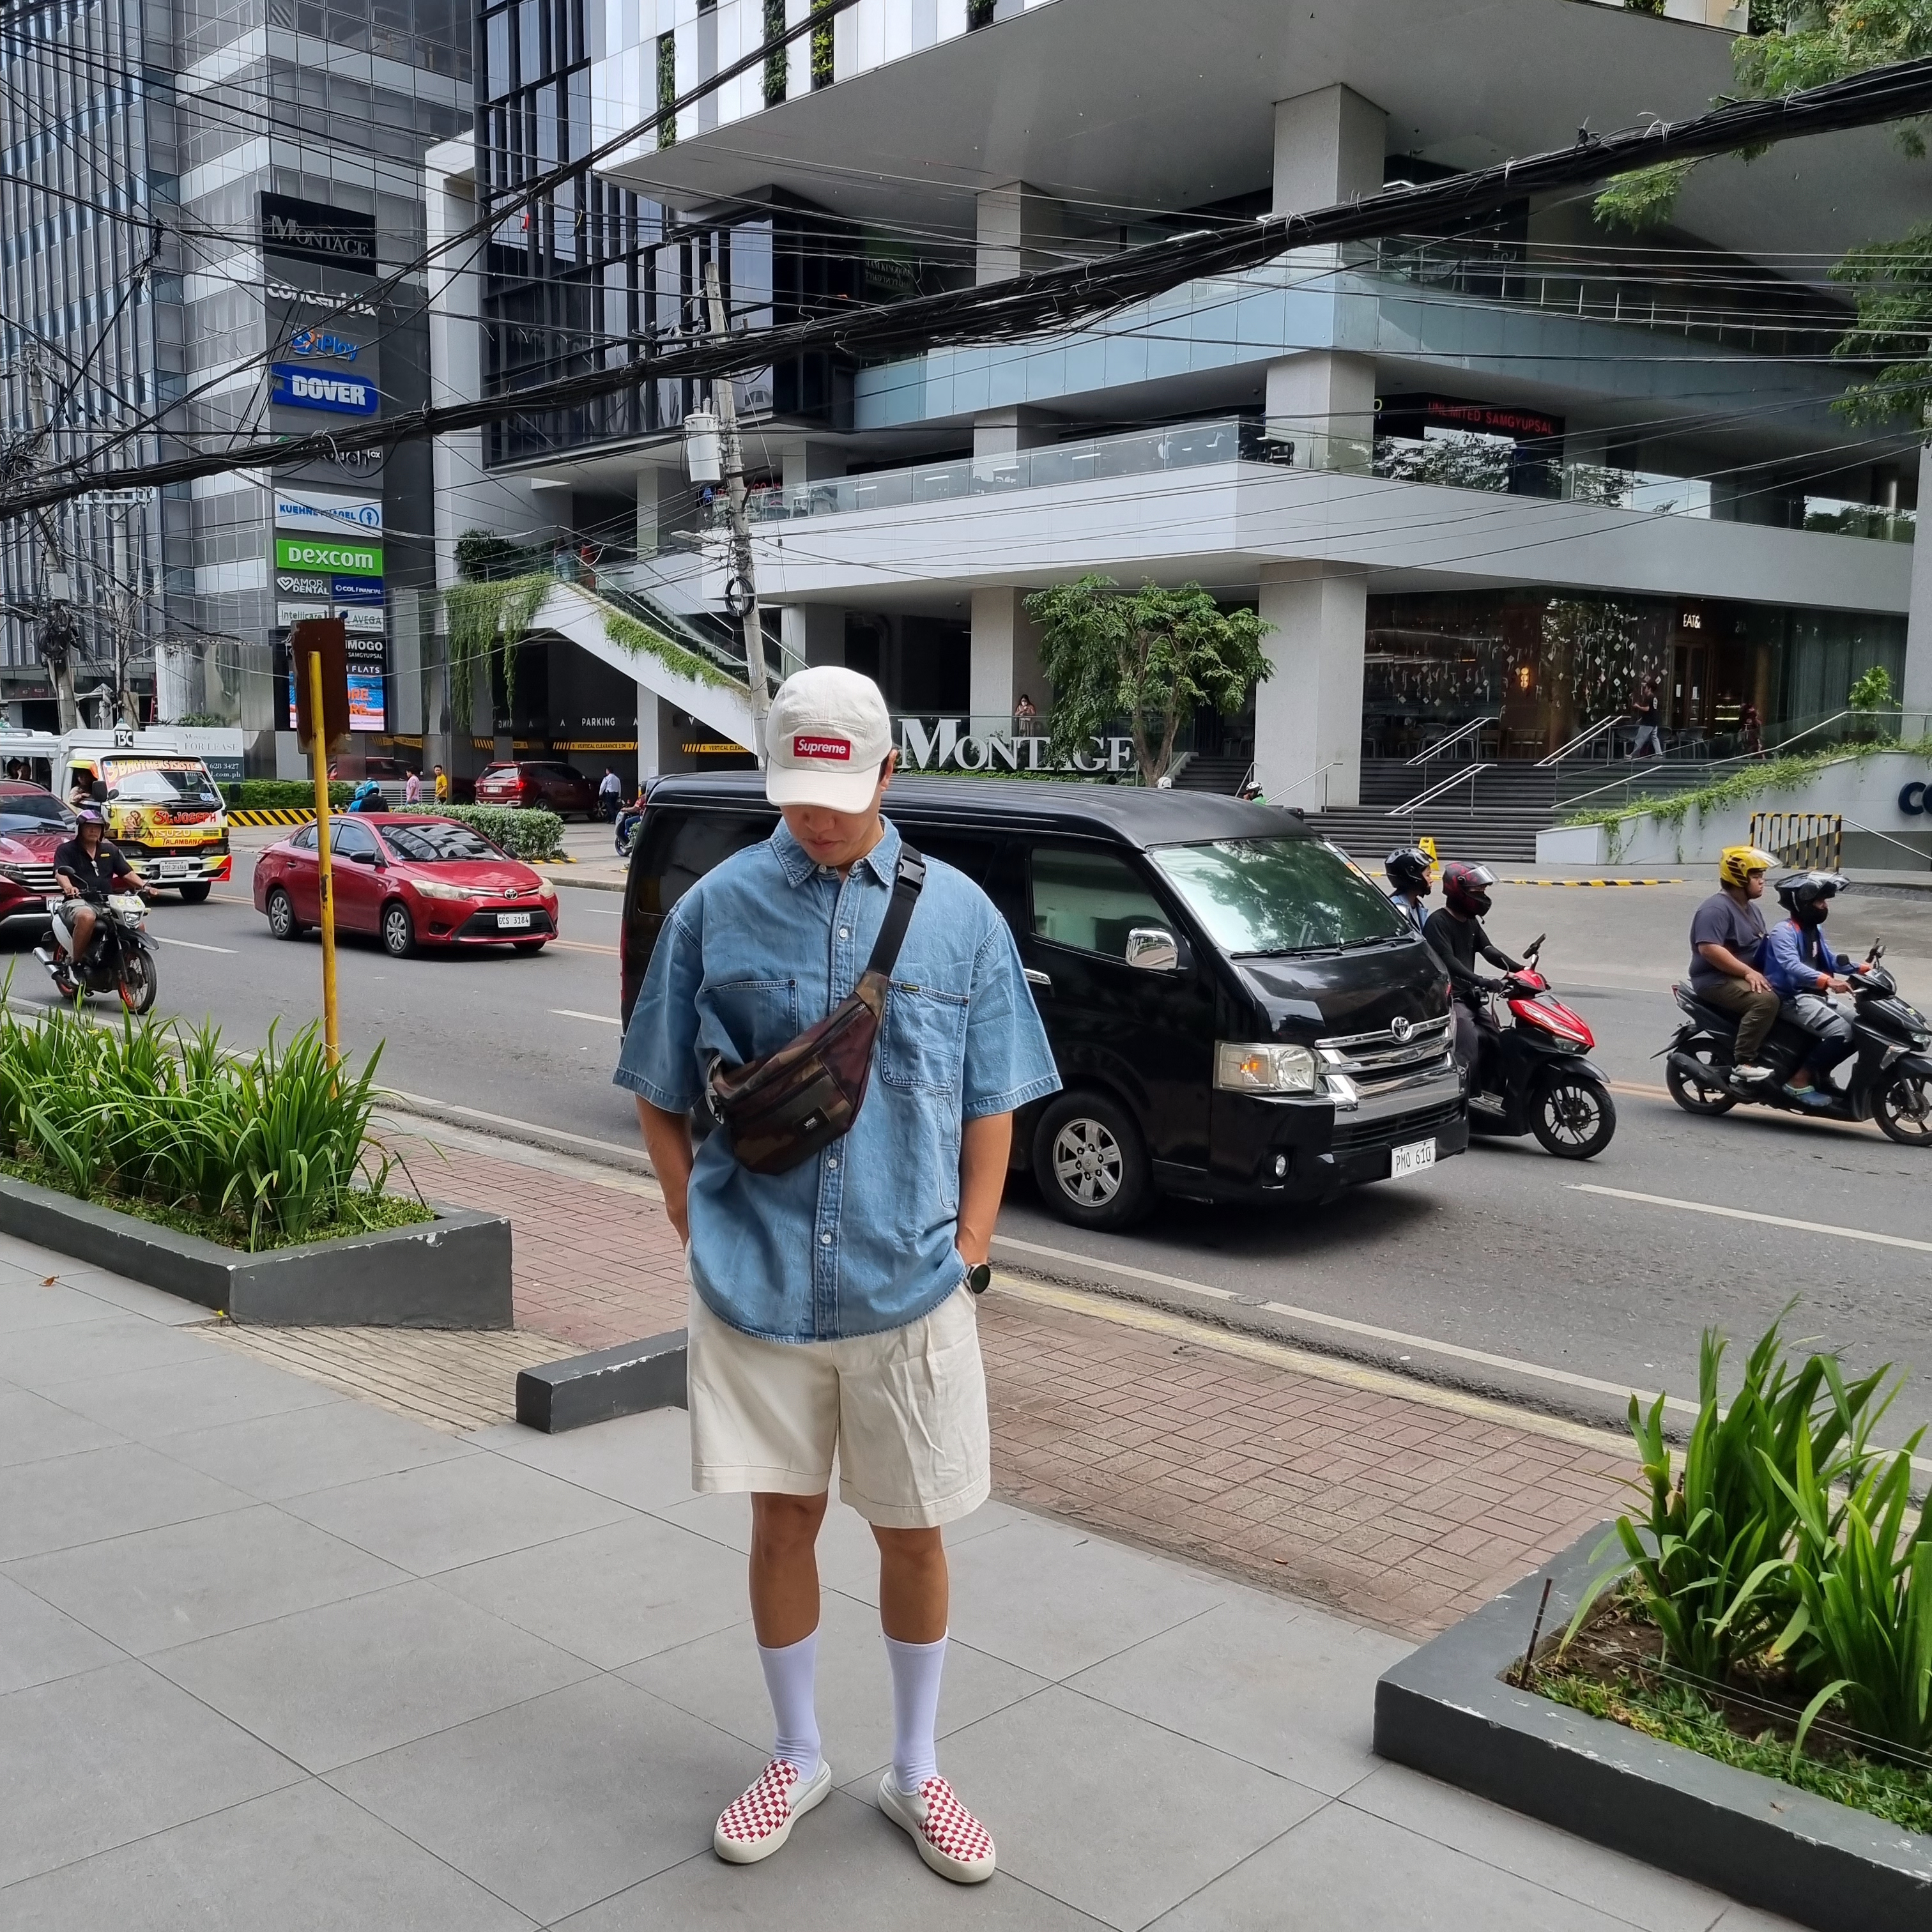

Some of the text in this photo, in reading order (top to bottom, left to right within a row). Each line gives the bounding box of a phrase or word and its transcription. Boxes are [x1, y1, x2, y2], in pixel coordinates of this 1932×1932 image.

[292, 374, 365, 406] DOVER
[1485, 411, 1553, 435] SAMGYUPSAL
[288, 547, 373, 569] Dexcom
[293, 578, 323, 588] AMOR
[293, 586, 330, 595] DENTAL
[353, 615, 382, 625] AVEGA
[346, 640, 383, 650] MOGO
[582, 717, 615, 726] PARKING
[116, 730, 133, 746] 13C
[897, 719, 1135, 771] MONTGE
[207, 743, 238, 751] LEASE
[797, 739, 846, 755] Supreme
[173, 811, 216, 823] JOSEPH
[1415, 1146, 1431, 1165] 610
